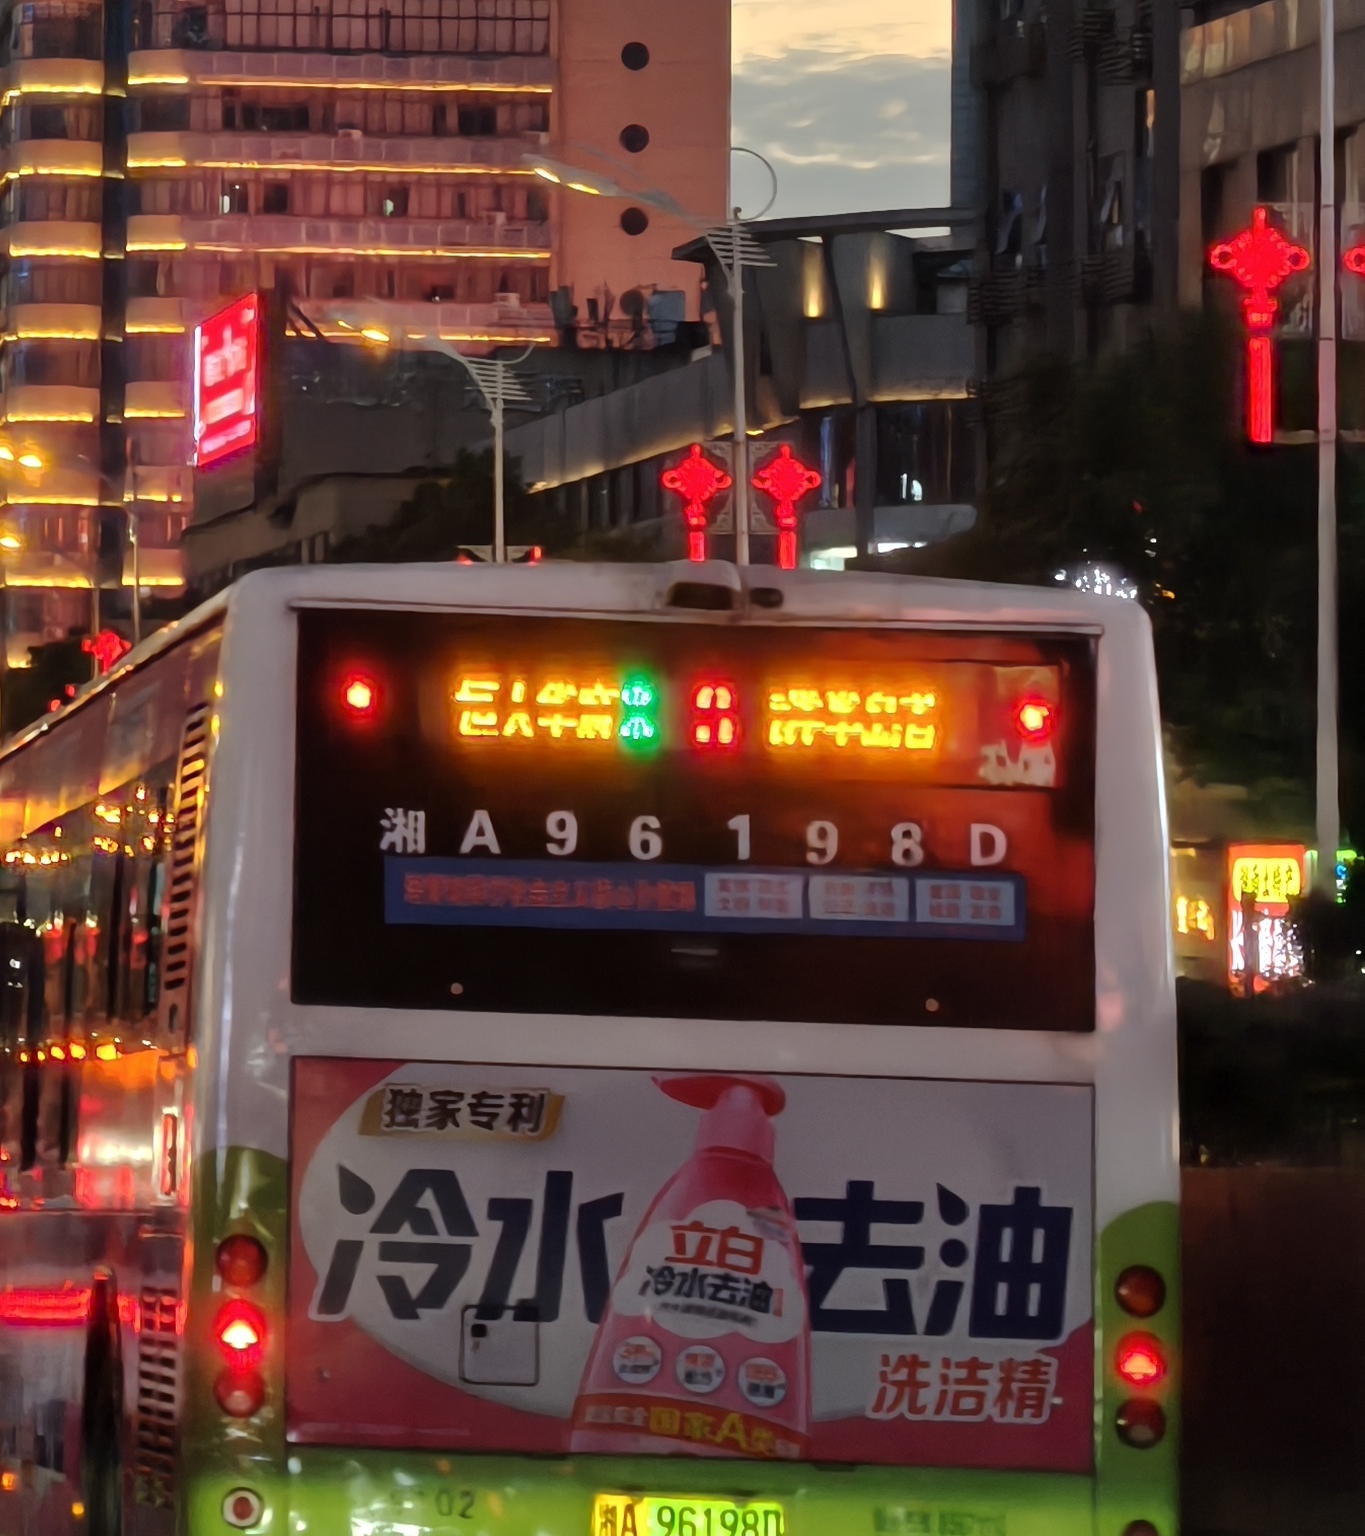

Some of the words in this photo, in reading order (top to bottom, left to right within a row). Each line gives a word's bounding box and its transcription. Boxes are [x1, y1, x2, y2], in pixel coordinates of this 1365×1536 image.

[384, 1088, 546, 1133] 独家专利
[316, 1162, 626, 1326] 冷水
[791, 1179, 1073, 1341] 去油
[664, 1220, 764, 1276] 立白
[638, 1265, 774, 1314] 冷水去油
[871, 1353, 1052, 1419] 洗洁精
